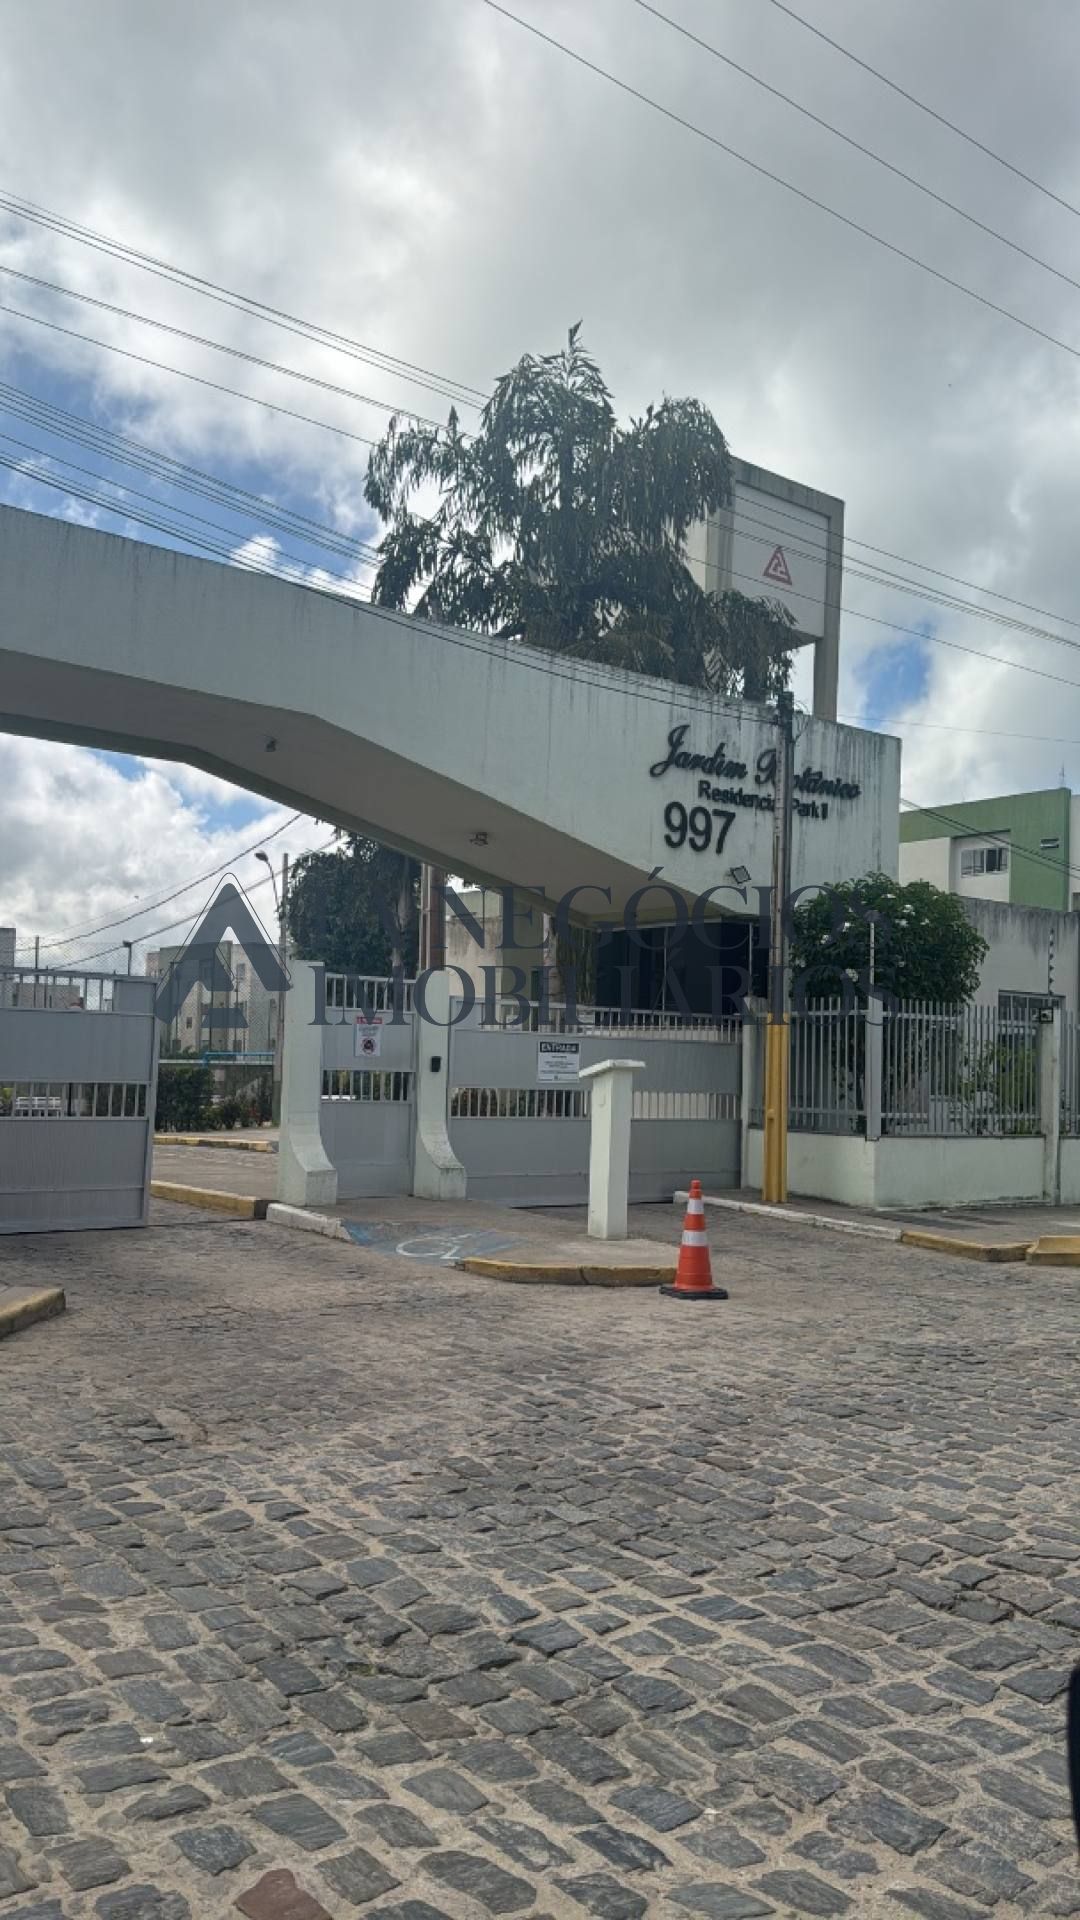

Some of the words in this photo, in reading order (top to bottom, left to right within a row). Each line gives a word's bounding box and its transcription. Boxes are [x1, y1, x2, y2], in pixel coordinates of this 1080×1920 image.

[650, 724, 749, 780] Jardim
[697, 779, 776, 813] Residenci
[664, 801, 736, 855] 997
